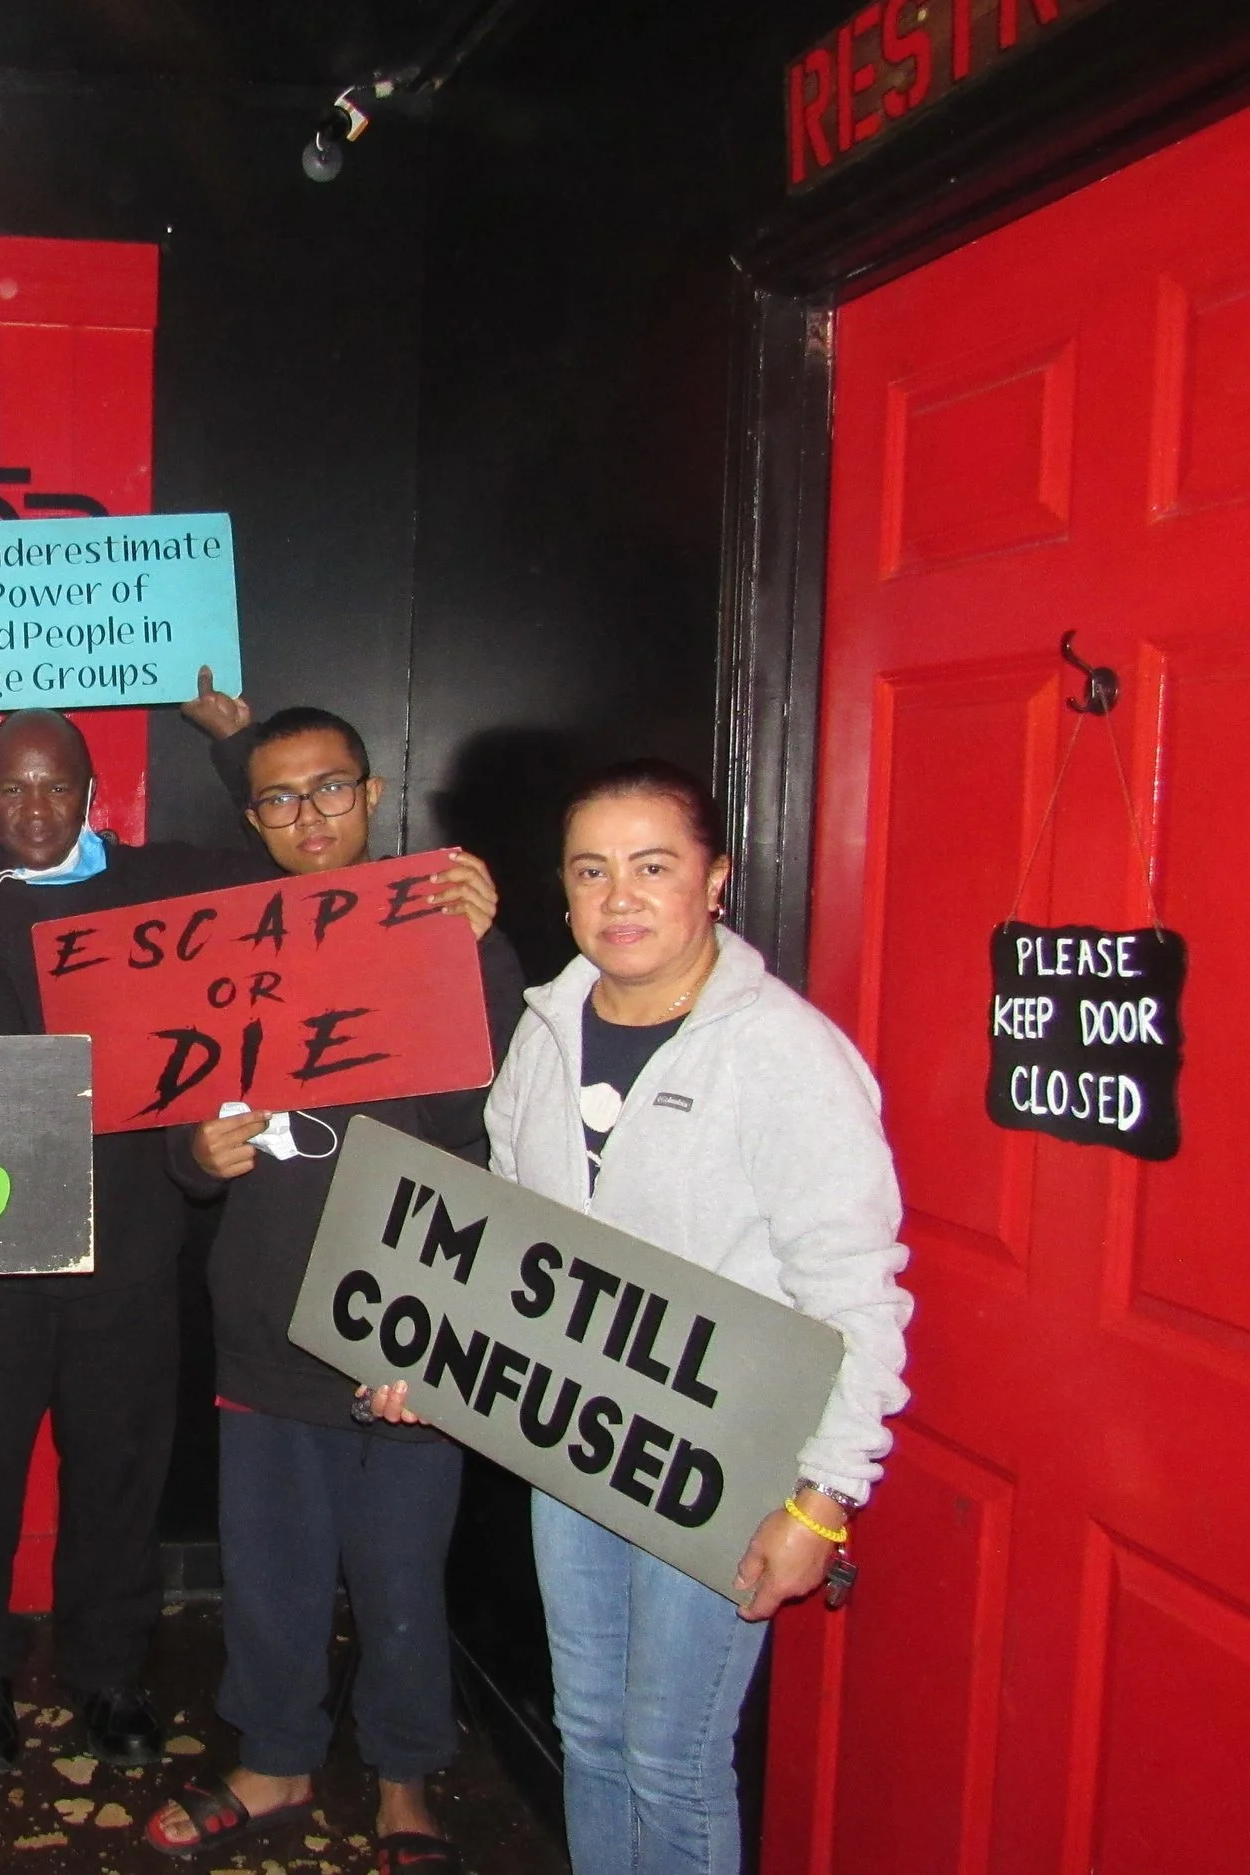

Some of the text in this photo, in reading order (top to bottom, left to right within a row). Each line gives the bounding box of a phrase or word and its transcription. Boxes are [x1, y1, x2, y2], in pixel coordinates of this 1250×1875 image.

[112, 573, 150, 603] of
[24, 616, 135, 654] People
[144, 615, 173, 644] in
[33, 661, 158, 694] Groups
[48, 874, 446, 977] ESCAPE
[1016, 936, 1141, 978] PLEASE
[207, 970, 285, 1009] OR
[993, 995, 1164, 1046] KEEP DOOR
[125, 1007, 402, 1124] DIE
[1011, 1065, 1143, 1132] CLOSED
[381, 1176, 718, 1409] I'M STILL
[332, 1269, 724, 1528] CONFUSED
